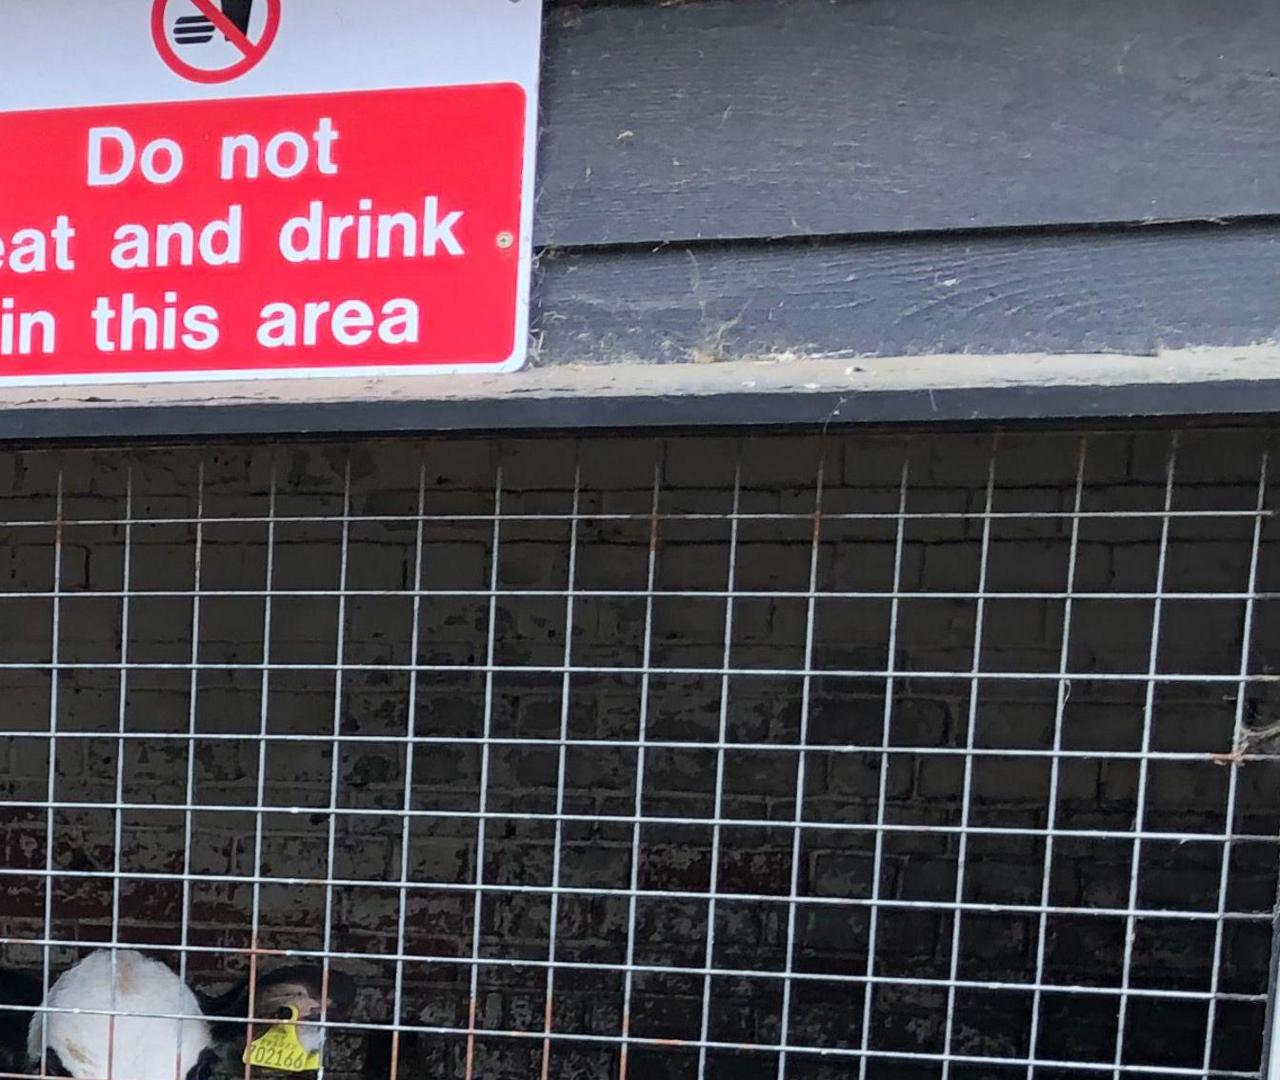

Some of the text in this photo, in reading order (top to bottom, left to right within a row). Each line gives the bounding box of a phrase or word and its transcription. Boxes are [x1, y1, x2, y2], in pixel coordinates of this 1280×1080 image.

[86, 117, 338, 187] Do not
[110, 204, 242, 269] and
[278, 195, 465, 263] drink
[0, 291, 419, 355] in this area
